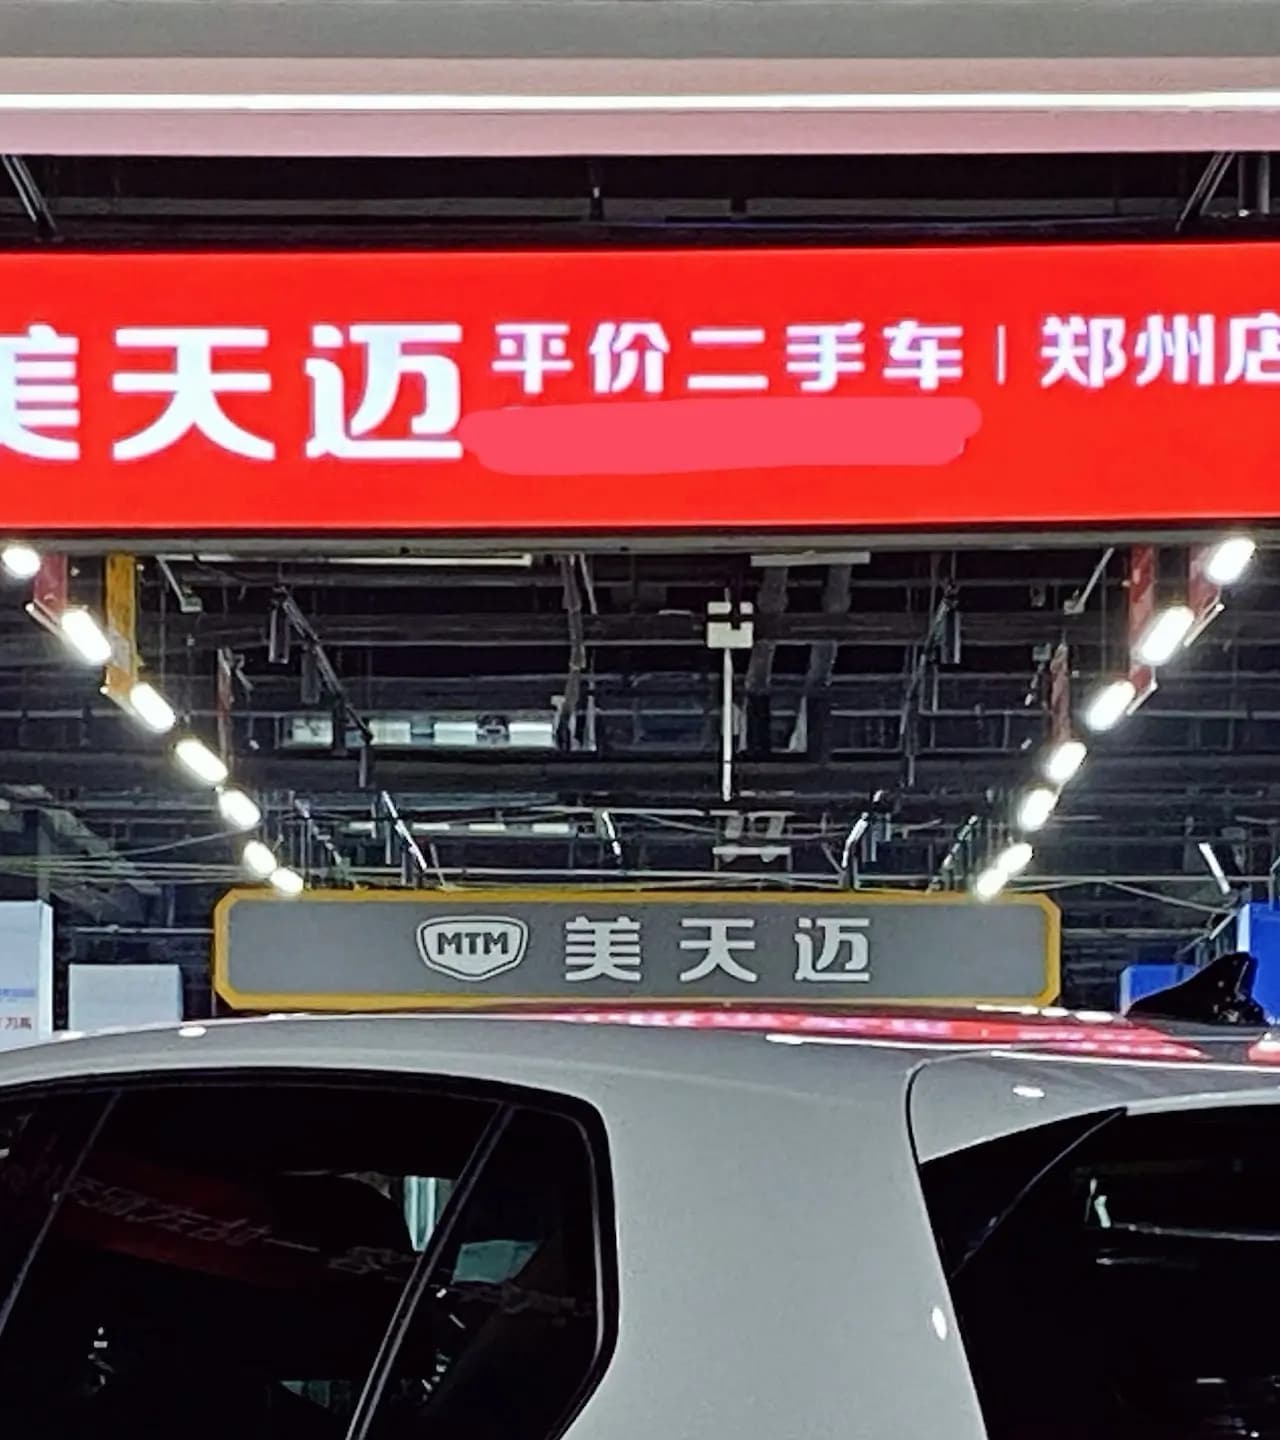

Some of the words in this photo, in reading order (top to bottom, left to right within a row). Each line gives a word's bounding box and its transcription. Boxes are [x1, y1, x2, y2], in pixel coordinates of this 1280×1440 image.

[491, 321, 964, 393] 平价二手车
[437, 931, 509, 955] MTM
[565, 916, 871, 982] 美天迈
